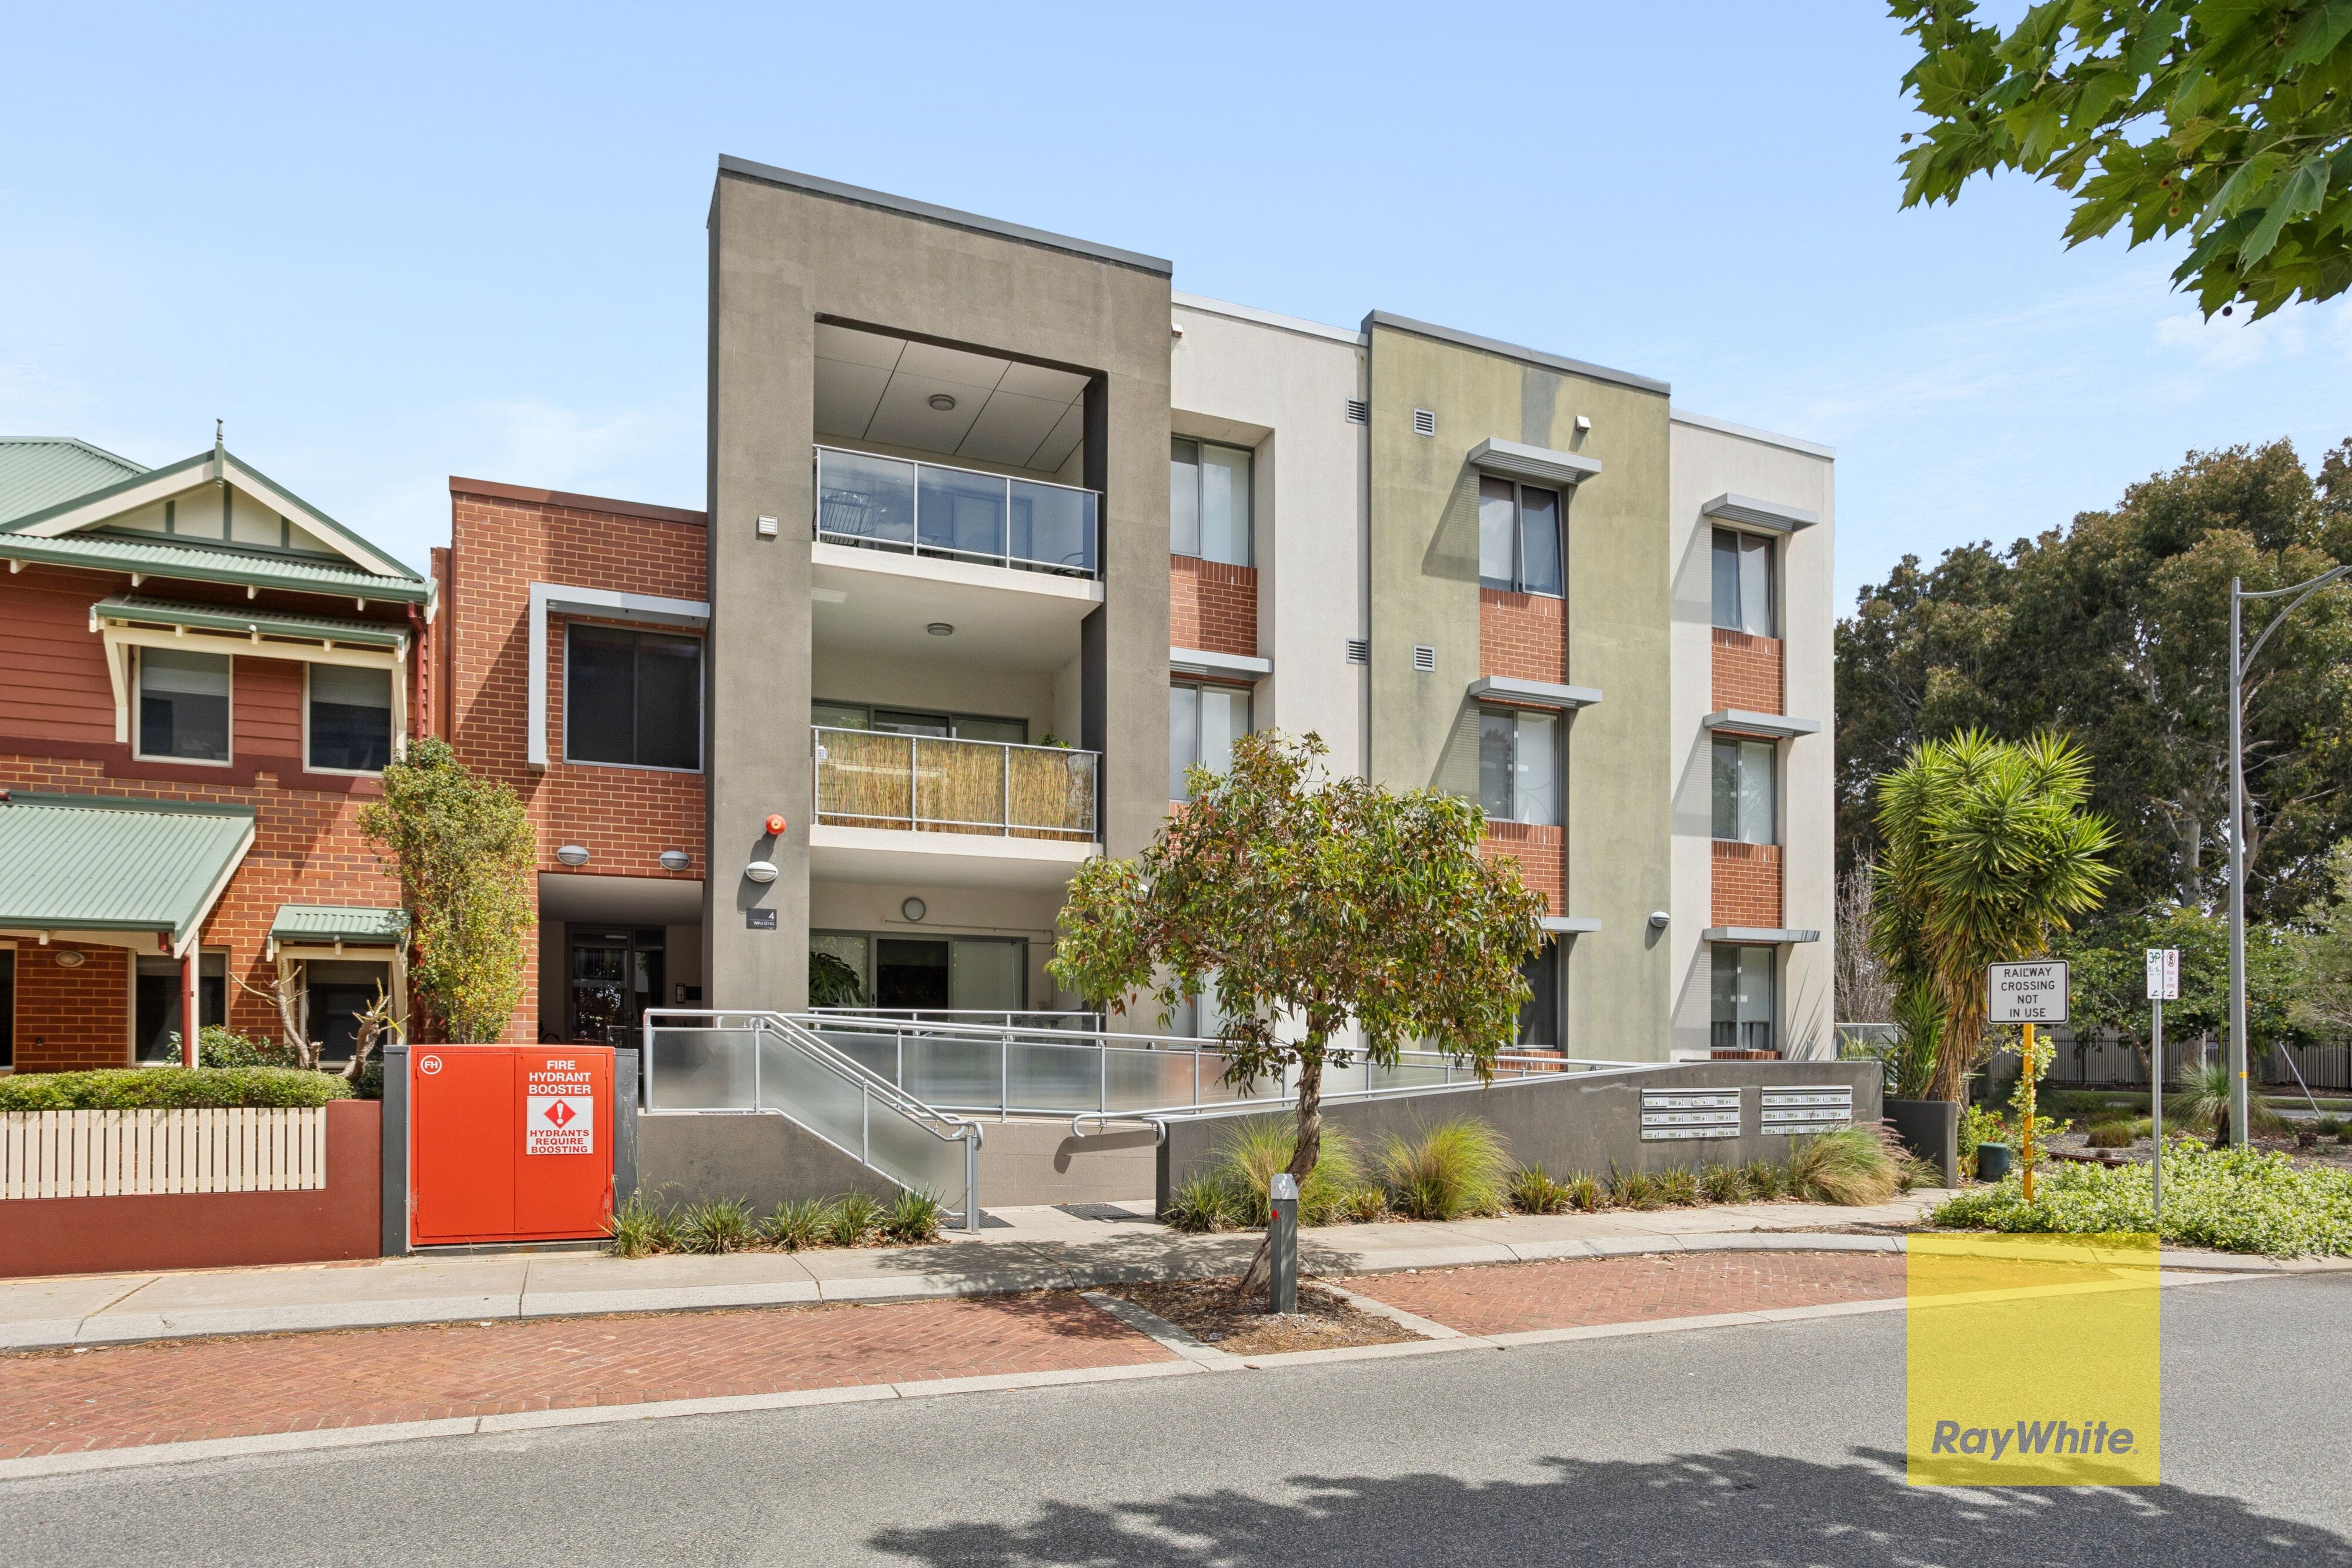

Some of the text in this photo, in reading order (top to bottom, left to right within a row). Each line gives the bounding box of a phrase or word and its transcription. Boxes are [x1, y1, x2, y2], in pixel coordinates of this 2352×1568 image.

[2149, 952, 2160, 963] 3P
[2004, 967, 2052, 978] RAILWAY
[2001, 981, 2055, 991] CROSSING
[2017, 995, 2039, 1004] NOT
[2010, 1008, 2046, 1018] IN USE
[547, 1060, 576, 1070] FIRE
[529, 1072, 592, 1082] HYDRANT
[529, 1084, 592, 1094] BOOSTER
